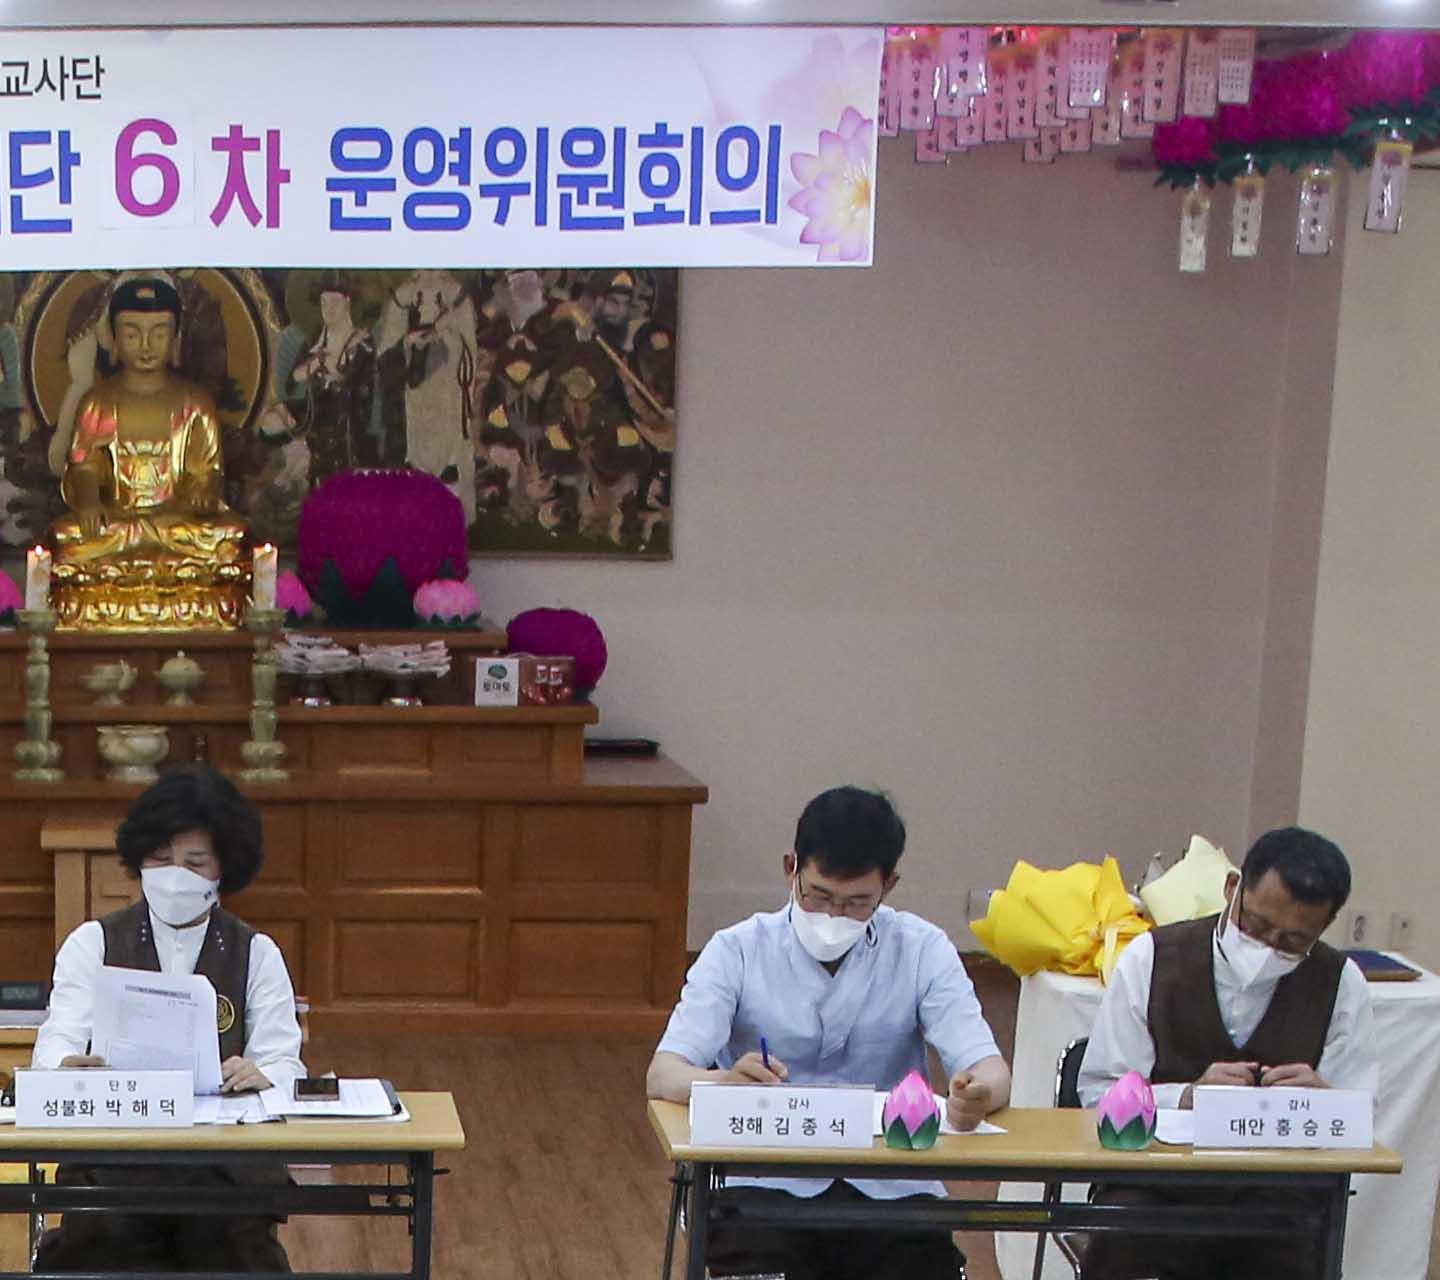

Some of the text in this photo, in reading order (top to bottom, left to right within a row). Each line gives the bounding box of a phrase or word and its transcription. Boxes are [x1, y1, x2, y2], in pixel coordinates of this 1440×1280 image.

[115, 118, 180, 217] 6
[209, 124, 291, 229] 차
[326, 122, 790, 232] 운영위원회의
[43, 1099, 174, 1117] 성불화 박 해 덕
[788, 1098, 809, 1110] 감사
[1288, 1099, 1310, 1111] 감사
[729, 1116, 844, 1136] 청해 김 종 석
[1230, 1118, 1264, 1136] 대안
[1276, 1118, 1291, 1136] 홍
[1303, 1119, 1318, 1137] 승
